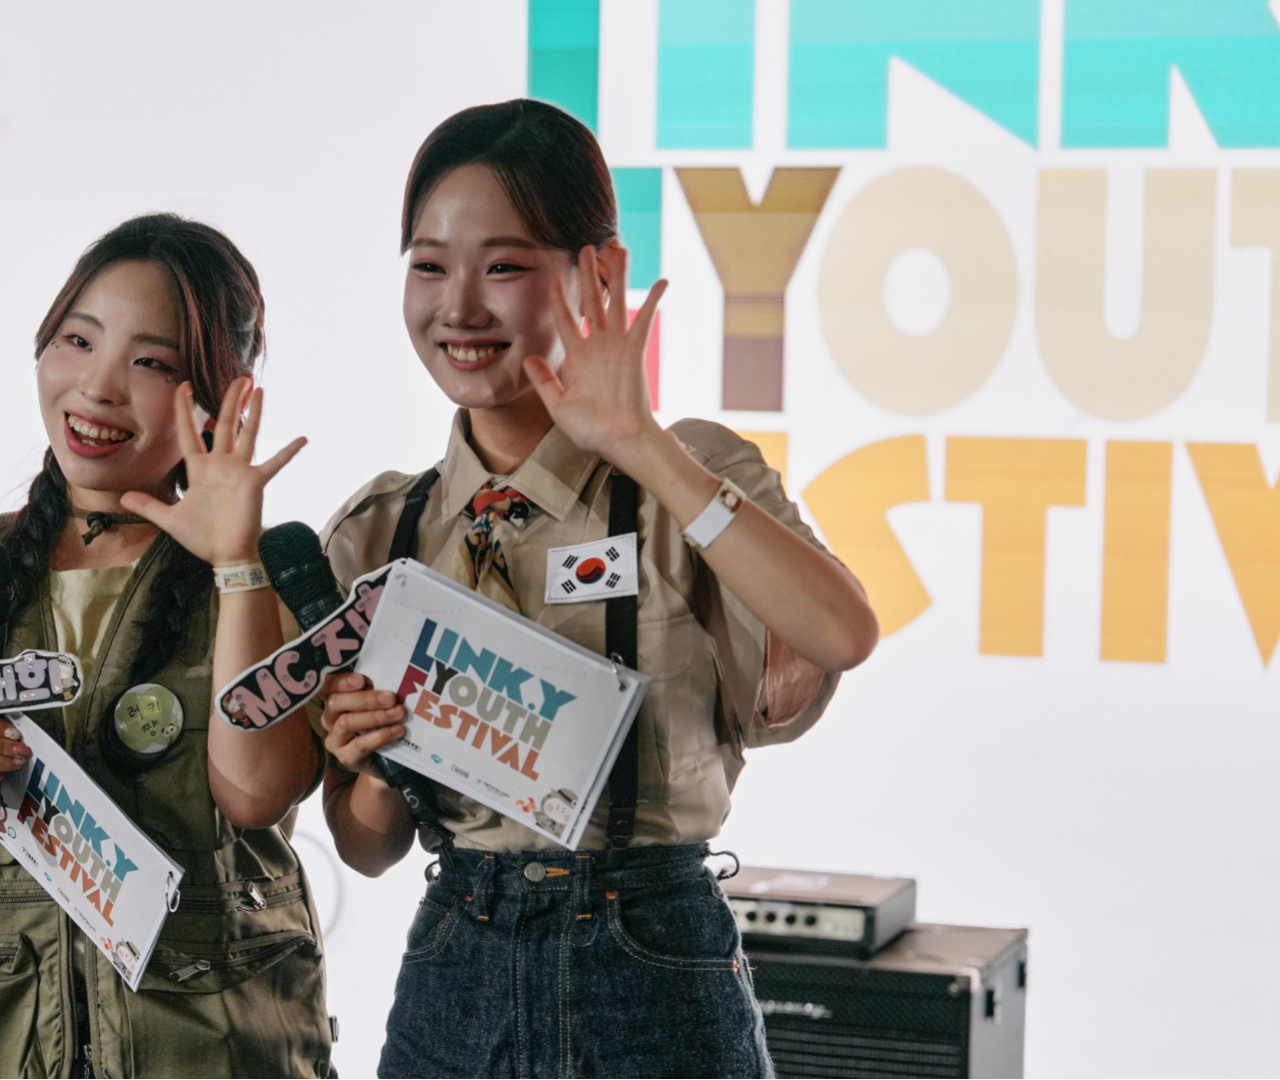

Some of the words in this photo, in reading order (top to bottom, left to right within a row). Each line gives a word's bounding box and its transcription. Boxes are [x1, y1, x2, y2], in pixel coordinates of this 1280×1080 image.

[231, 650, 318, 728] MC
[396, 663, 540, 782] FESTIVAL
[409, 617, 578, 722] LINK.Y
[431, 659, 553, 751] YOUTH
[17, 790, 116, 928] FESTIVAL
[26, 757, 140, 883] LINK.Y
[42, 794, 123, 904] YOUTH
